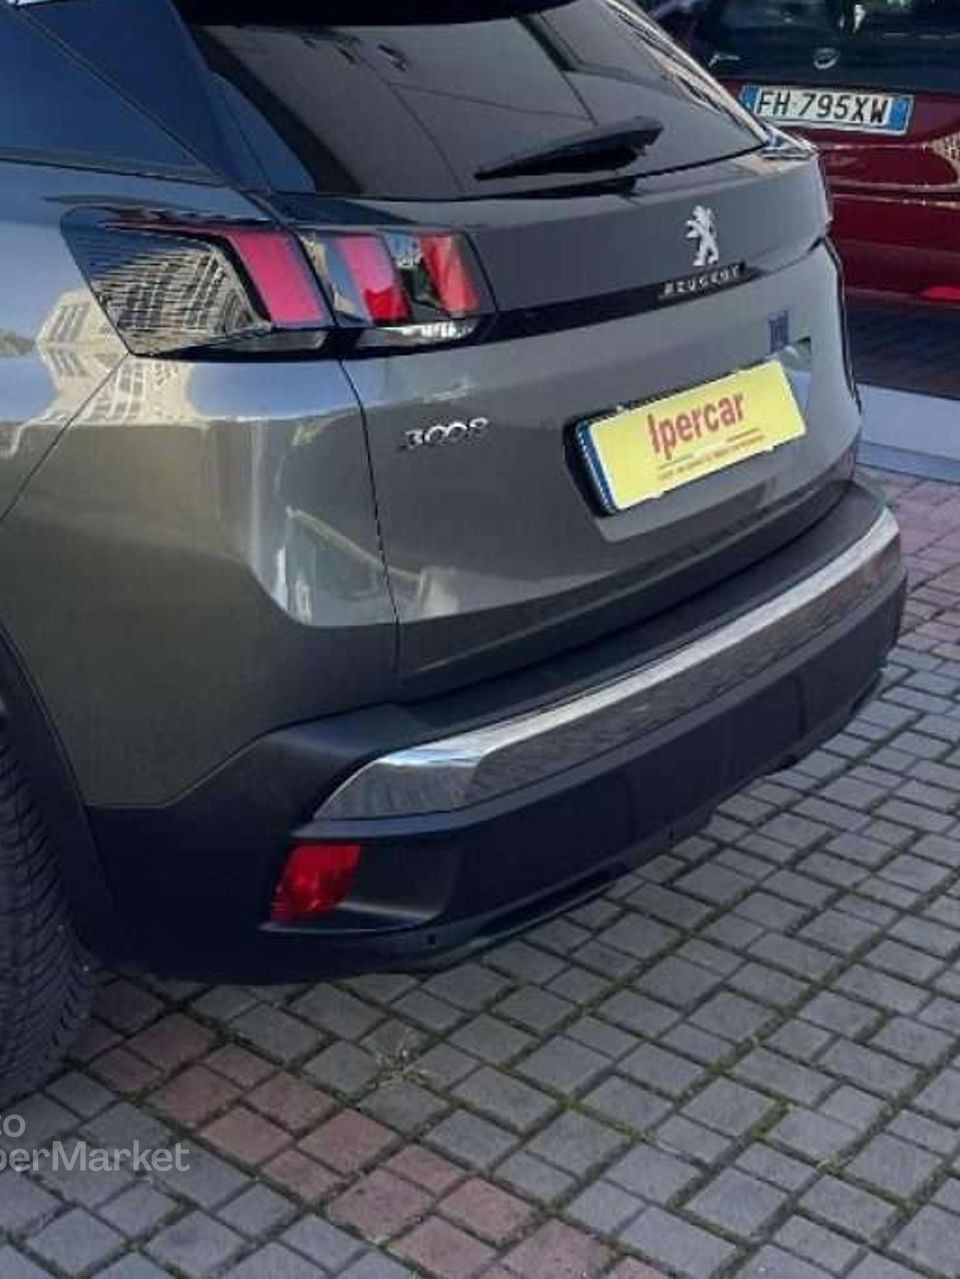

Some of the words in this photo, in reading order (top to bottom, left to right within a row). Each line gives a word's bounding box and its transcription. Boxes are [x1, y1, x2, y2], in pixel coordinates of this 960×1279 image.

[756, 91, 790, 115] FH
[798, 93, 889, 124] 795XW
[646, 390, 746, 461] Ipercar
